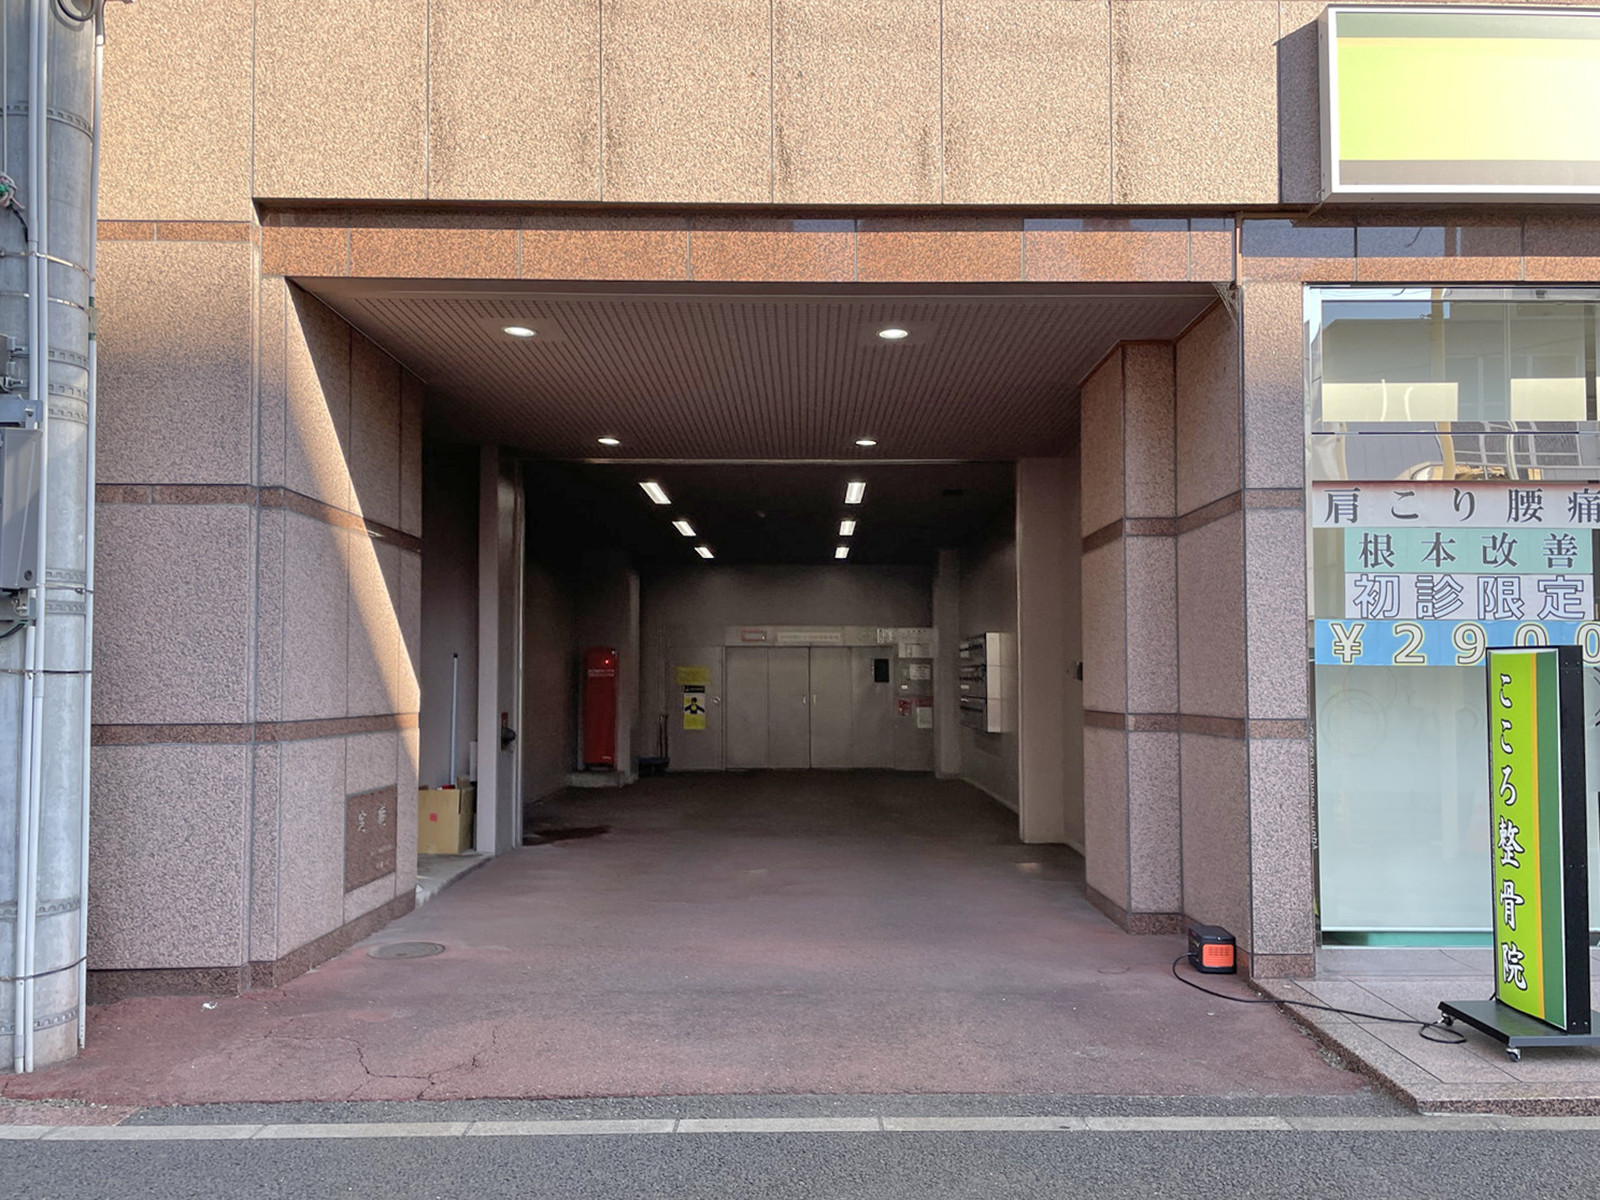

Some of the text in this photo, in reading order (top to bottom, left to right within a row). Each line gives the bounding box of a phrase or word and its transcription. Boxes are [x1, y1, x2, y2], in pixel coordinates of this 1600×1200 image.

[1324, 487, 1600, 524] 肩こり腰痛
[1358, 531, 1578, 568] 根本改善
[1353, 574, 1586, 620] 初診限定
[1498, 673, 1528, 991] こころ整骨院
